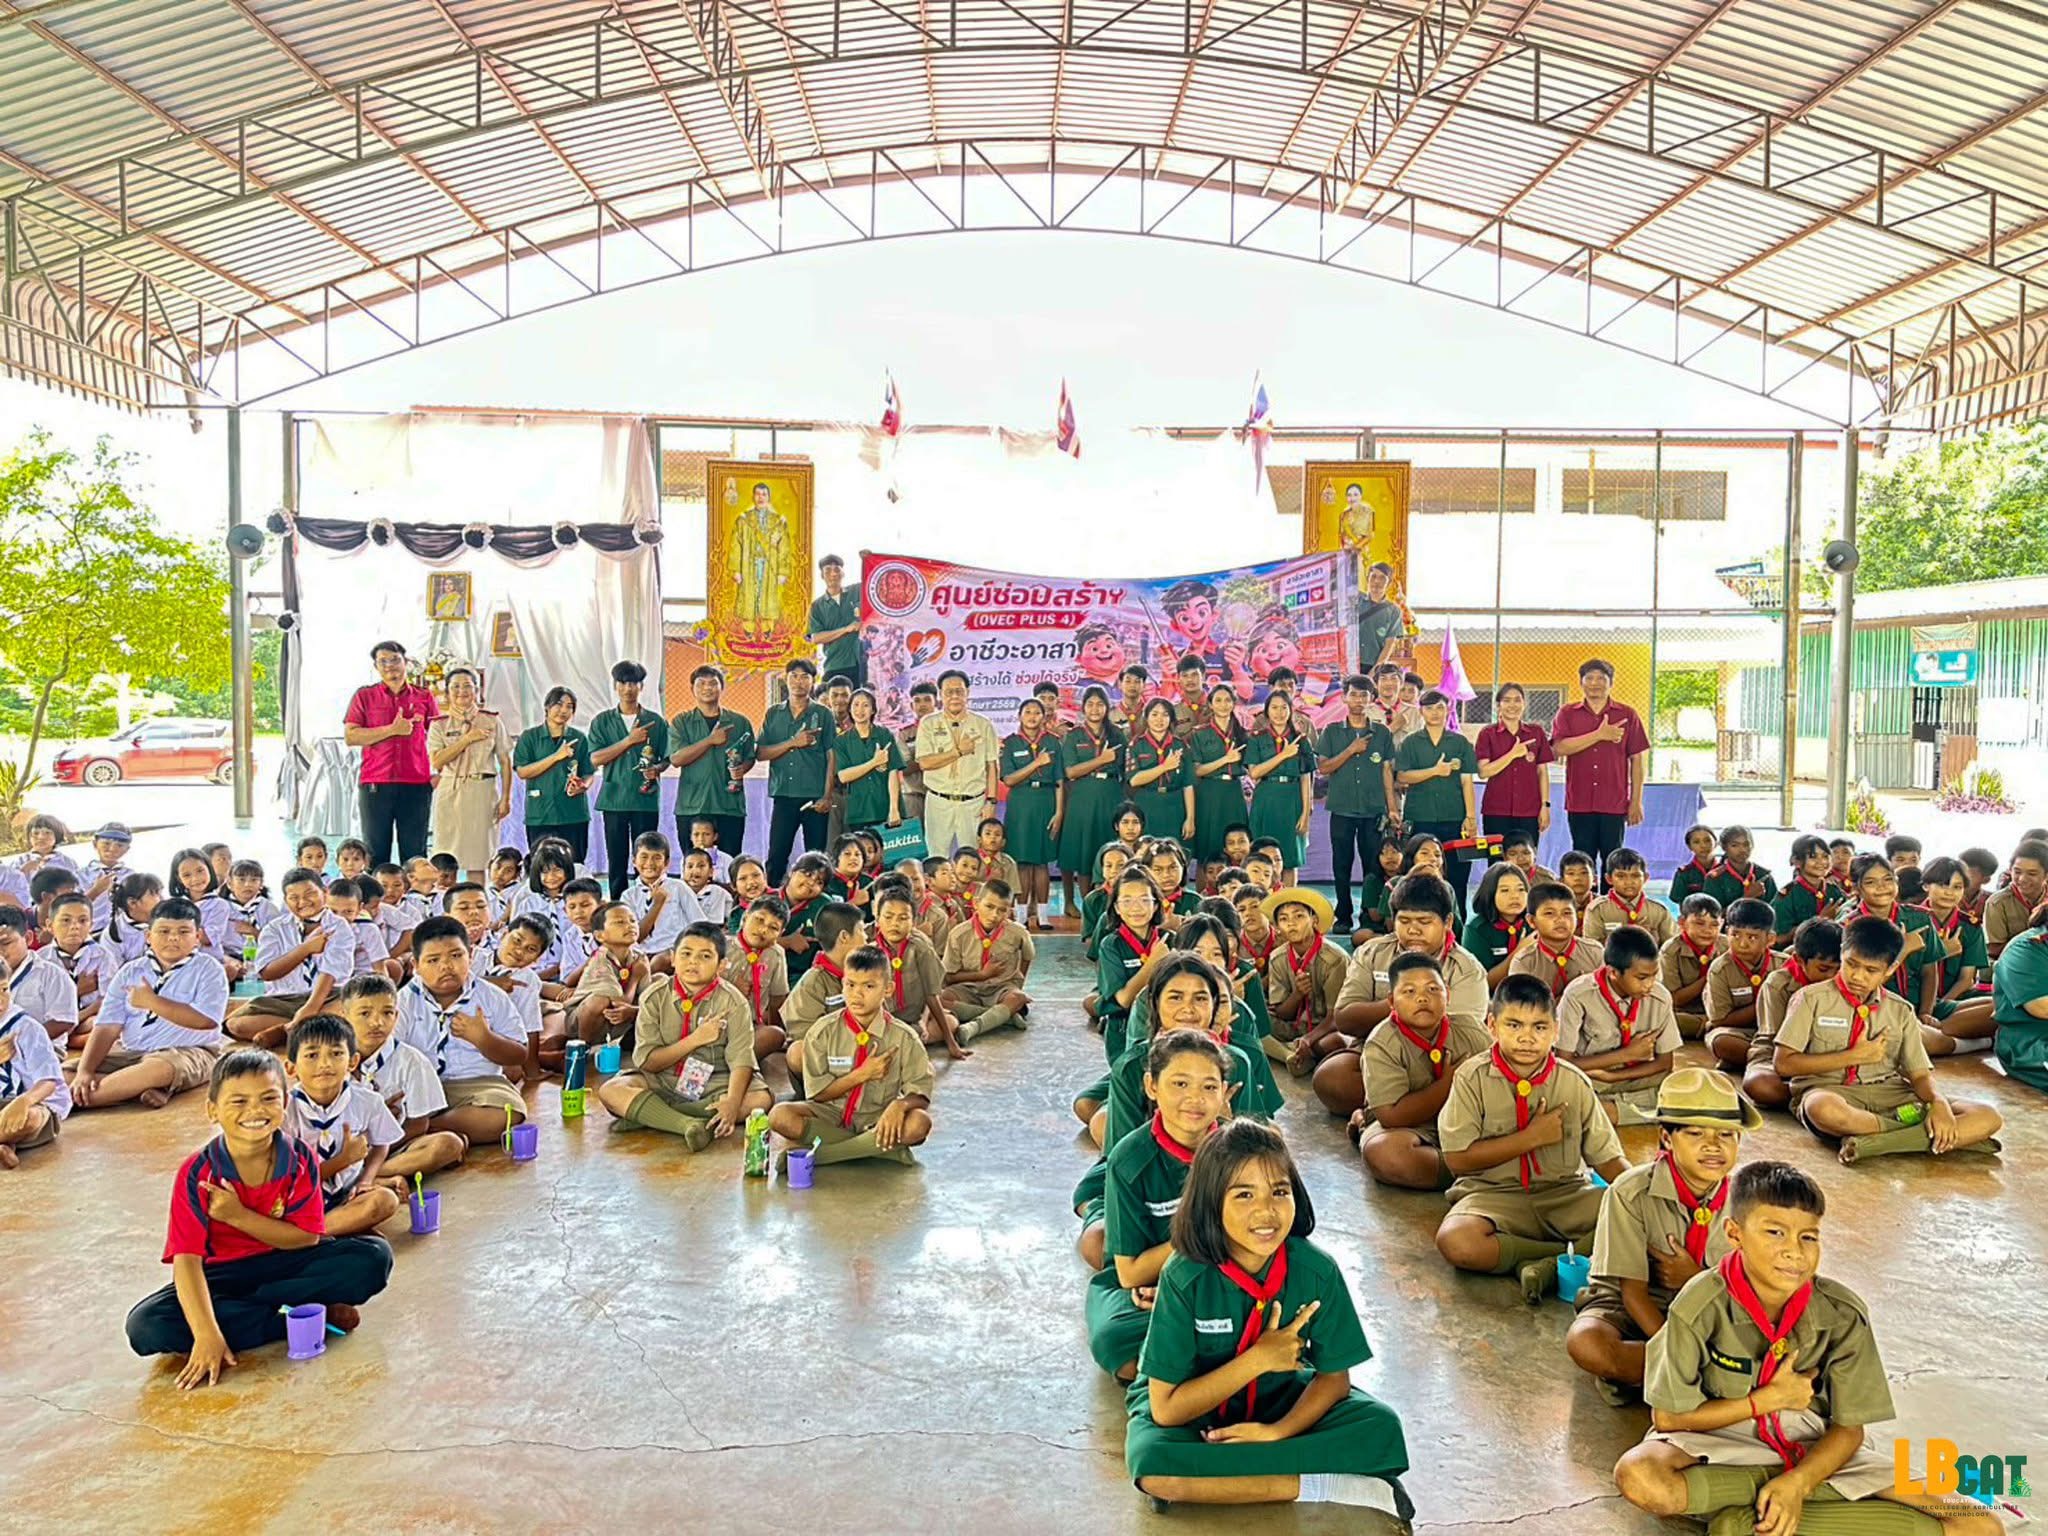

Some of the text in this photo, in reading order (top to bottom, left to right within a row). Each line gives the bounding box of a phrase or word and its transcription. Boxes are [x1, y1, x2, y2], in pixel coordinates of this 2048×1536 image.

[973, 612, 1077, 628] (OVEC PLUS 4)
[949, 637, 1077, 661] อาชีวะอาสา
